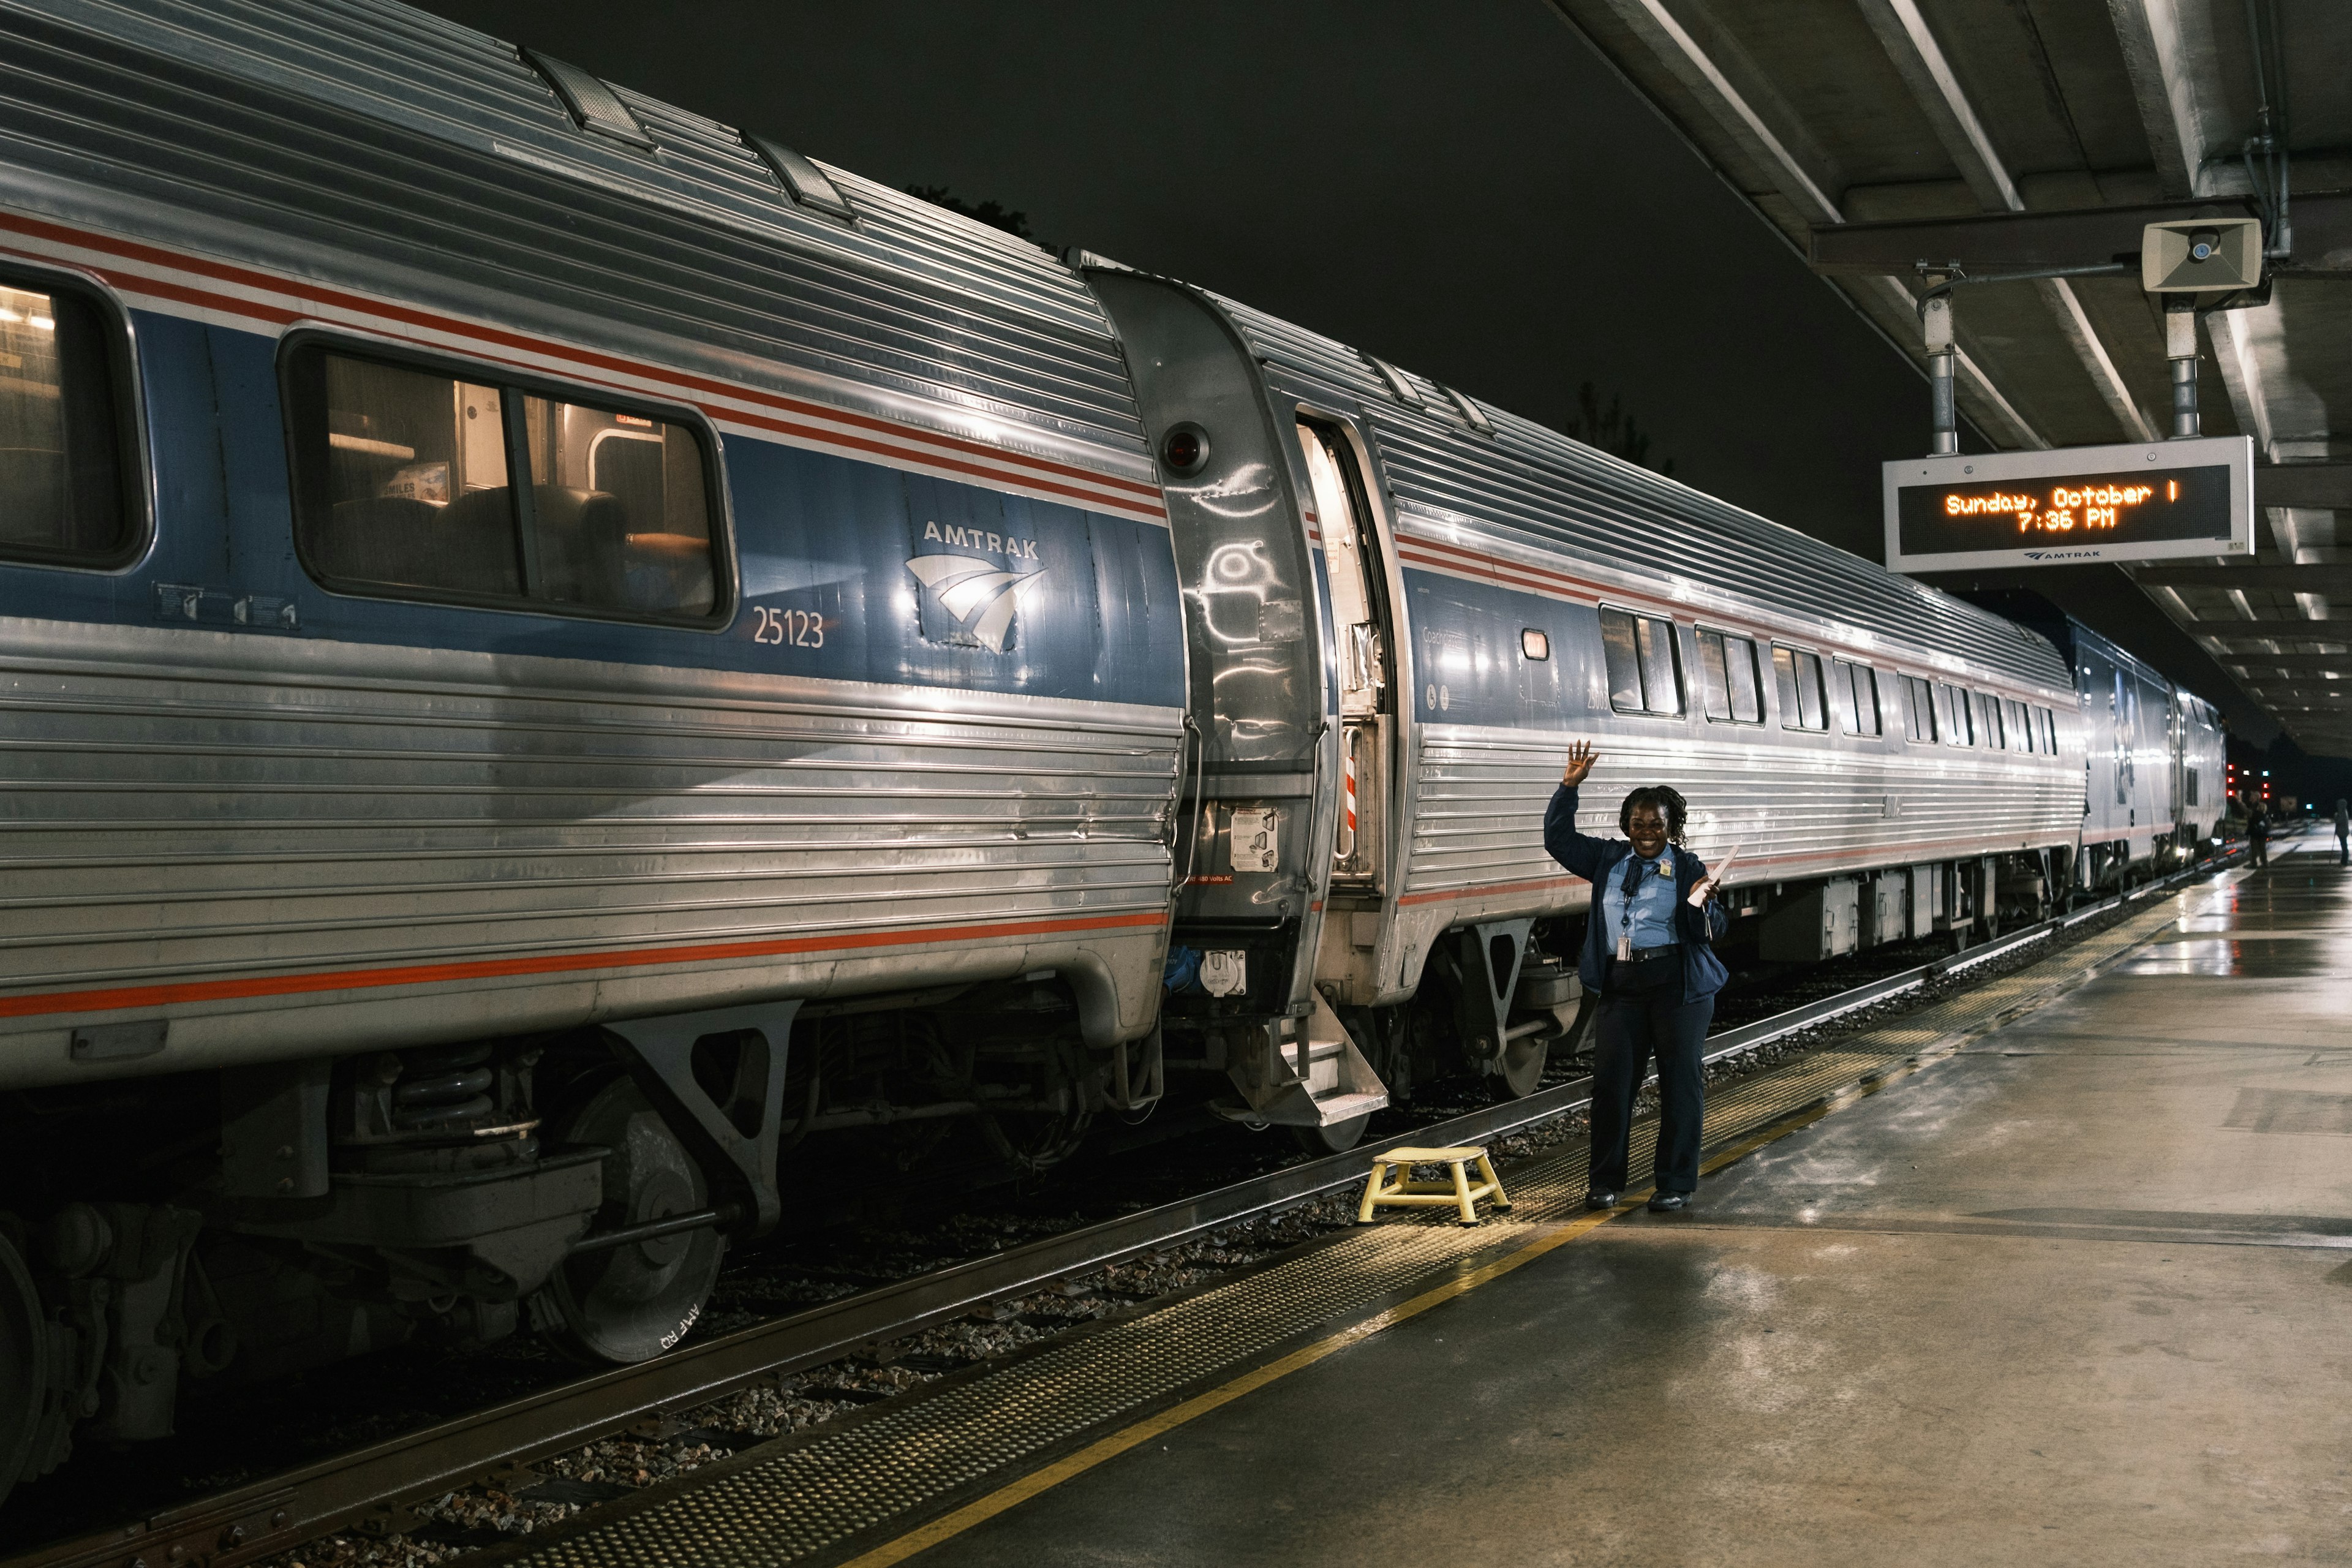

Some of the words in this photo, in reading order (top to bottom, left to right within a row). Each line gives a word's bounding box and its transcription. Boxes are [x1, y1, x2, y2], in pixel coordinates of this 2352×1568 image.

[1947, 491, 2037, 515] Sunday,
[2054, 483, 2152, 508] October
[2018, 509, 2074, 533] 7:36
[2086, 506, 2116, 530] PM
[924, 521, 1039, 560] AMTRAK
[2045, 551, 2100, 559] AMTRAK
[753, 606, 824, 649] 25123
